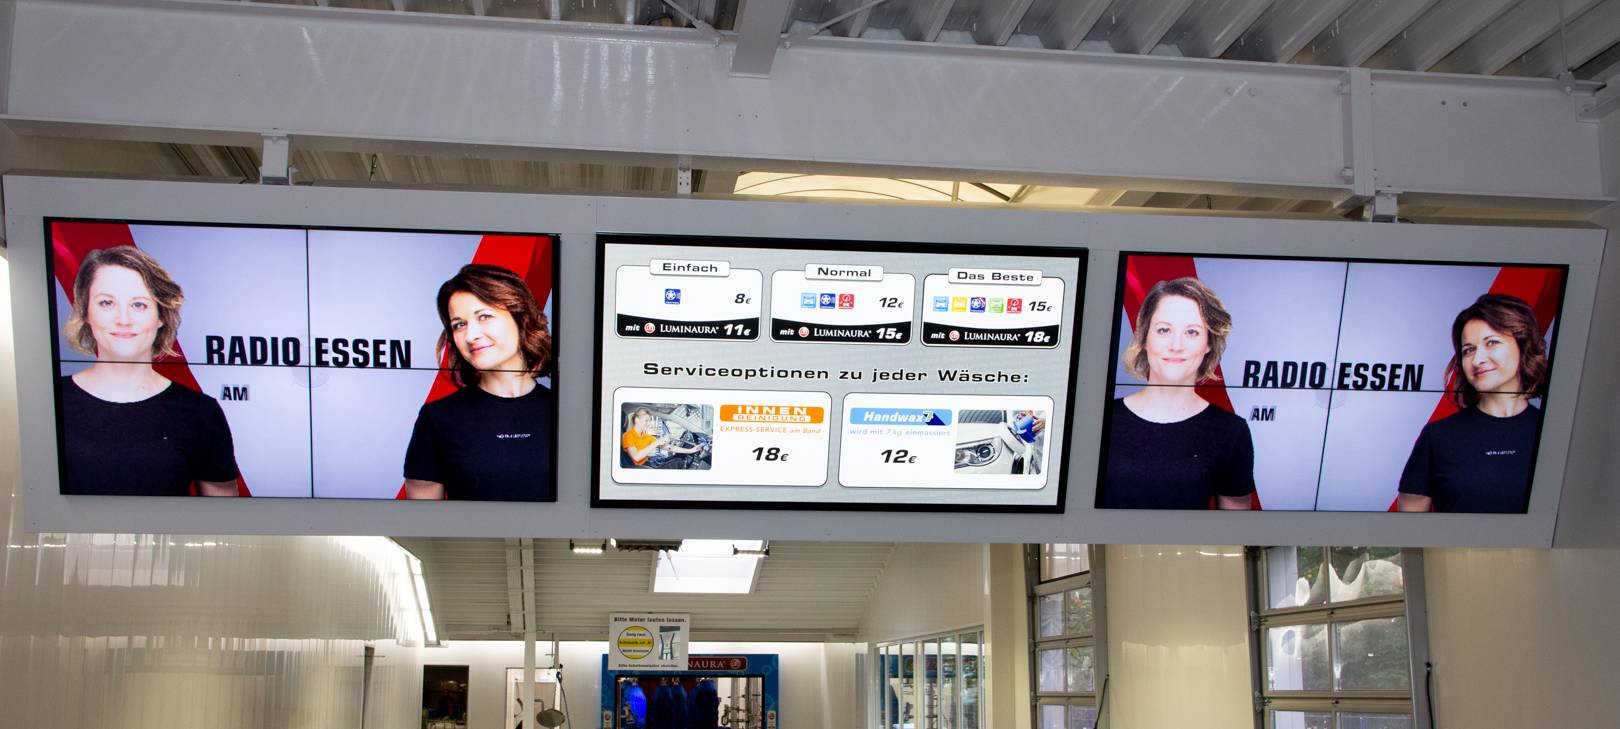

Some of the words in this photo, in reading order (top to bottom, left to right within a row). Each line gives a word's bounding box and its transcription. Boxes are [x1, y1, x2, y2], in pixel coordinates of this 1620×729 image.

[662, 262, 718, 273] Einfach
[817, 267, 872, 277] Normal
[957, 271, 985, 280] Das
[991, 272, 1034, 282] Beste
[625, 323, 641, 332] mit
[780, 326, 795, 336] mit
[931, 331, 946, 339] mit
[205, 335, 301, 366] RADIO
[314, 337, 411, 368] ESSEN
[643, 362, 829, 380] Serviceoptionen
[839, 370, 862, 380] zu
[871, 368, 928, 383] jeder
[937, 369, 1029, 383] Wäsche:
[1242, 360, 1327, 390] RADIO
[1336, 362, 1424, 391] ESSEN
[222, 386, 248, 401] AM
[737, 405, 807, 415] INNEN
[1250, 407, 1275, 421] AM
[737, 414, 806, 422] REINIGUNG
[720, 425, 753, 433] EXPRESS
